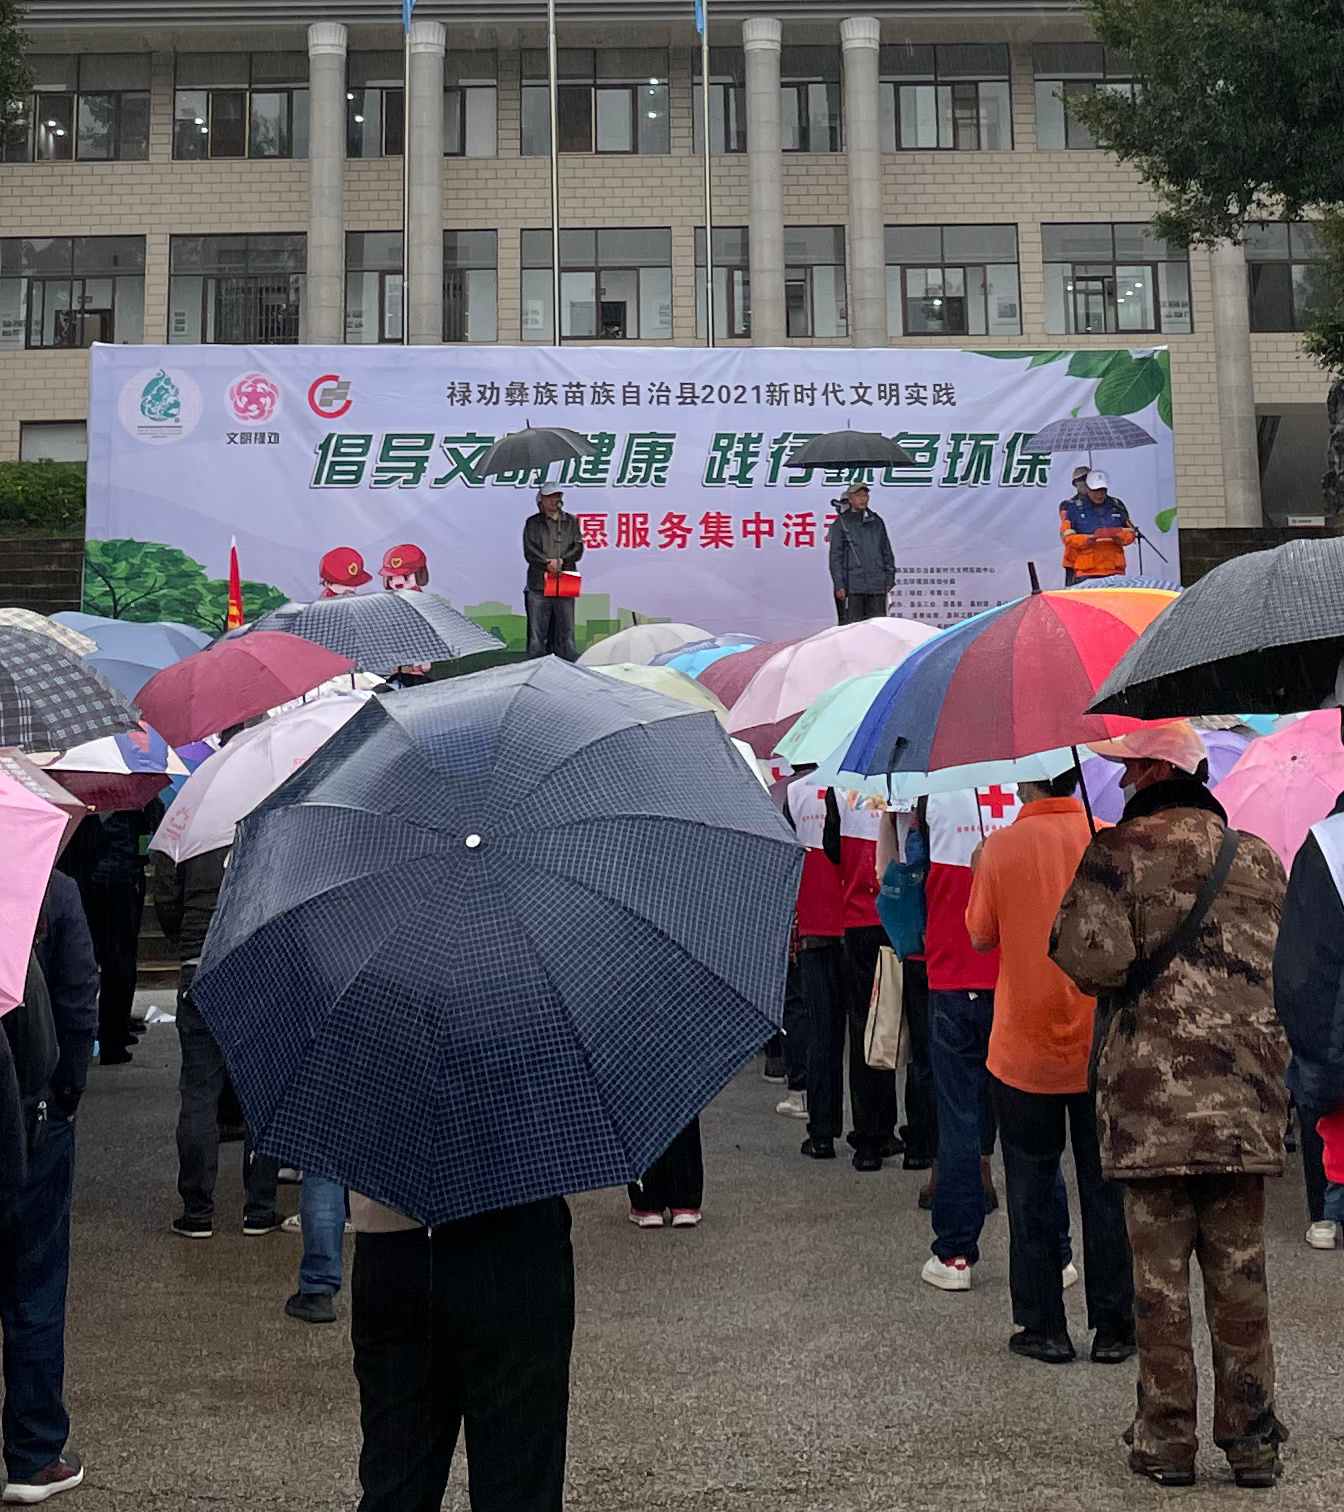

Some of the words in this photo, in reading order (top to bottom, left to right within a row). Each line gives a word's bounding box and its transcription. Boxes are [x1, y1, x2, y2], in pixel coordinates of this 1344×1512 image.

[446, 380, 957, 408] 禄劝彝族苗族自治县2021新时代文明实践
[311, 431, 677, 488] 倡导文健康
[702, 430, 1052, 487] 践行色环保
